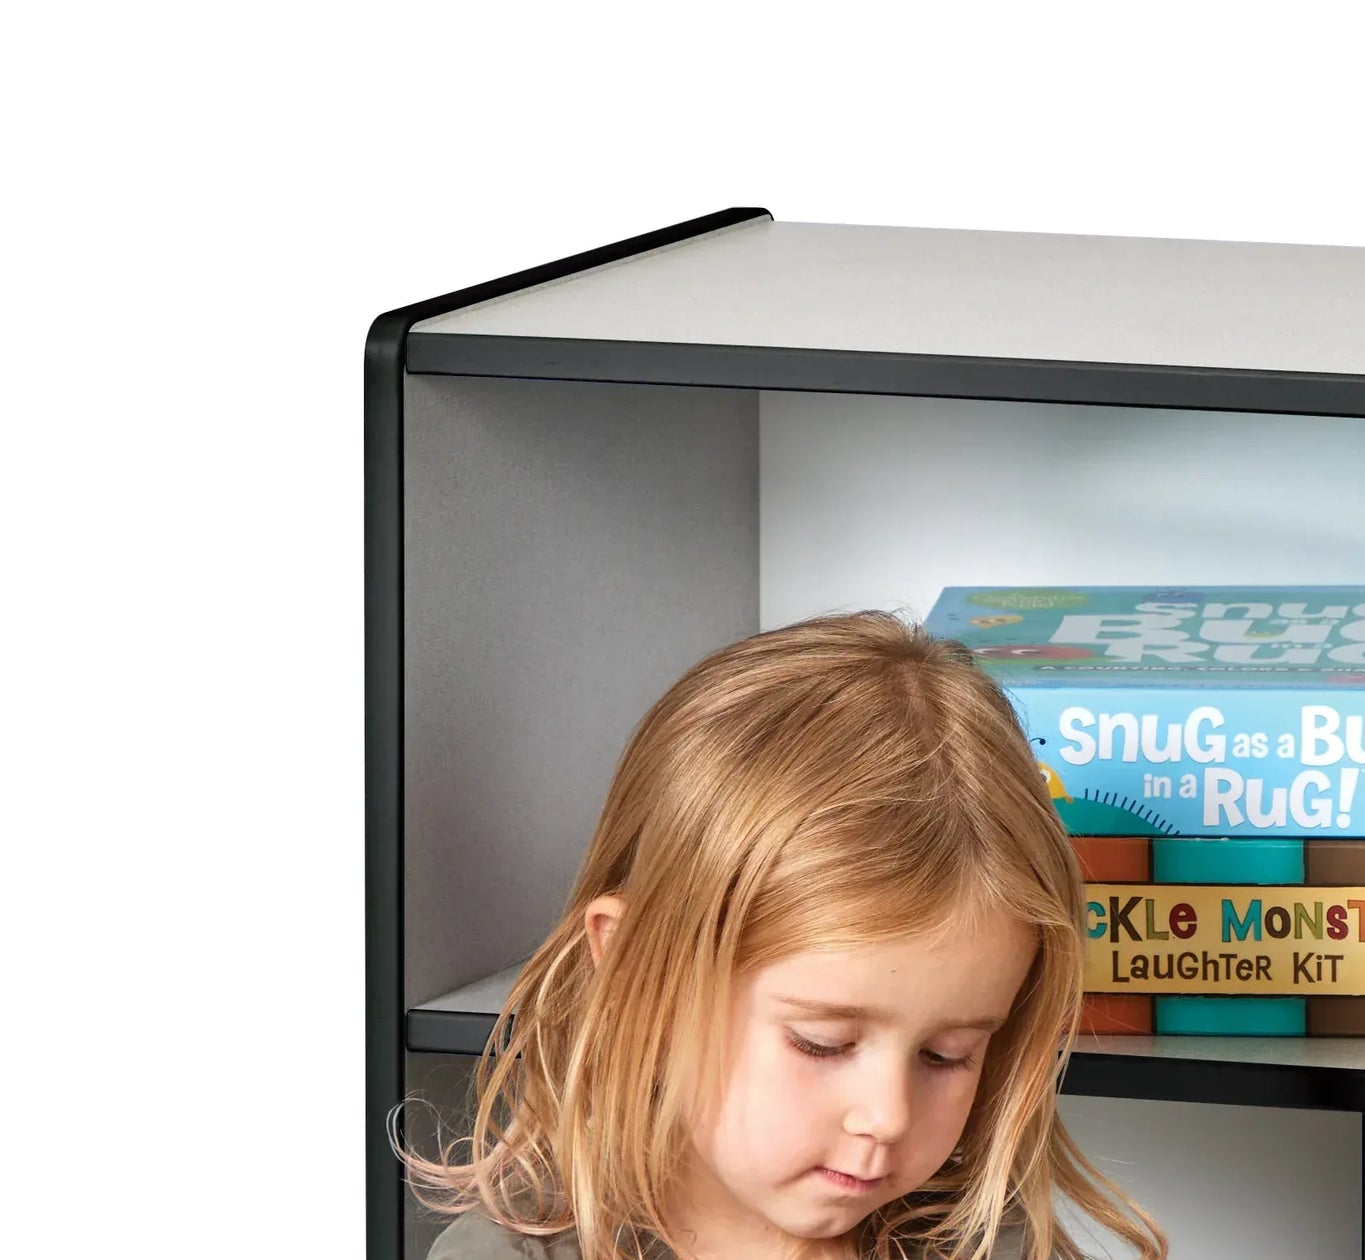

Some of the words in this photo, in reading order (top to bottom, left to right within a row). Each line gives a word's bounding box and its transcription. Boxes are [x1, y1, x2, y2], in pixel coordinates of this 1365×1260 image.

[1058, 706, 1227, 766] SnuG
[1232, 732, 1269, 759] as
[1276, 732, 1296, 759] a
[1143, 773, 1172, 799] in
[1178, 773, 1198, 799] a
